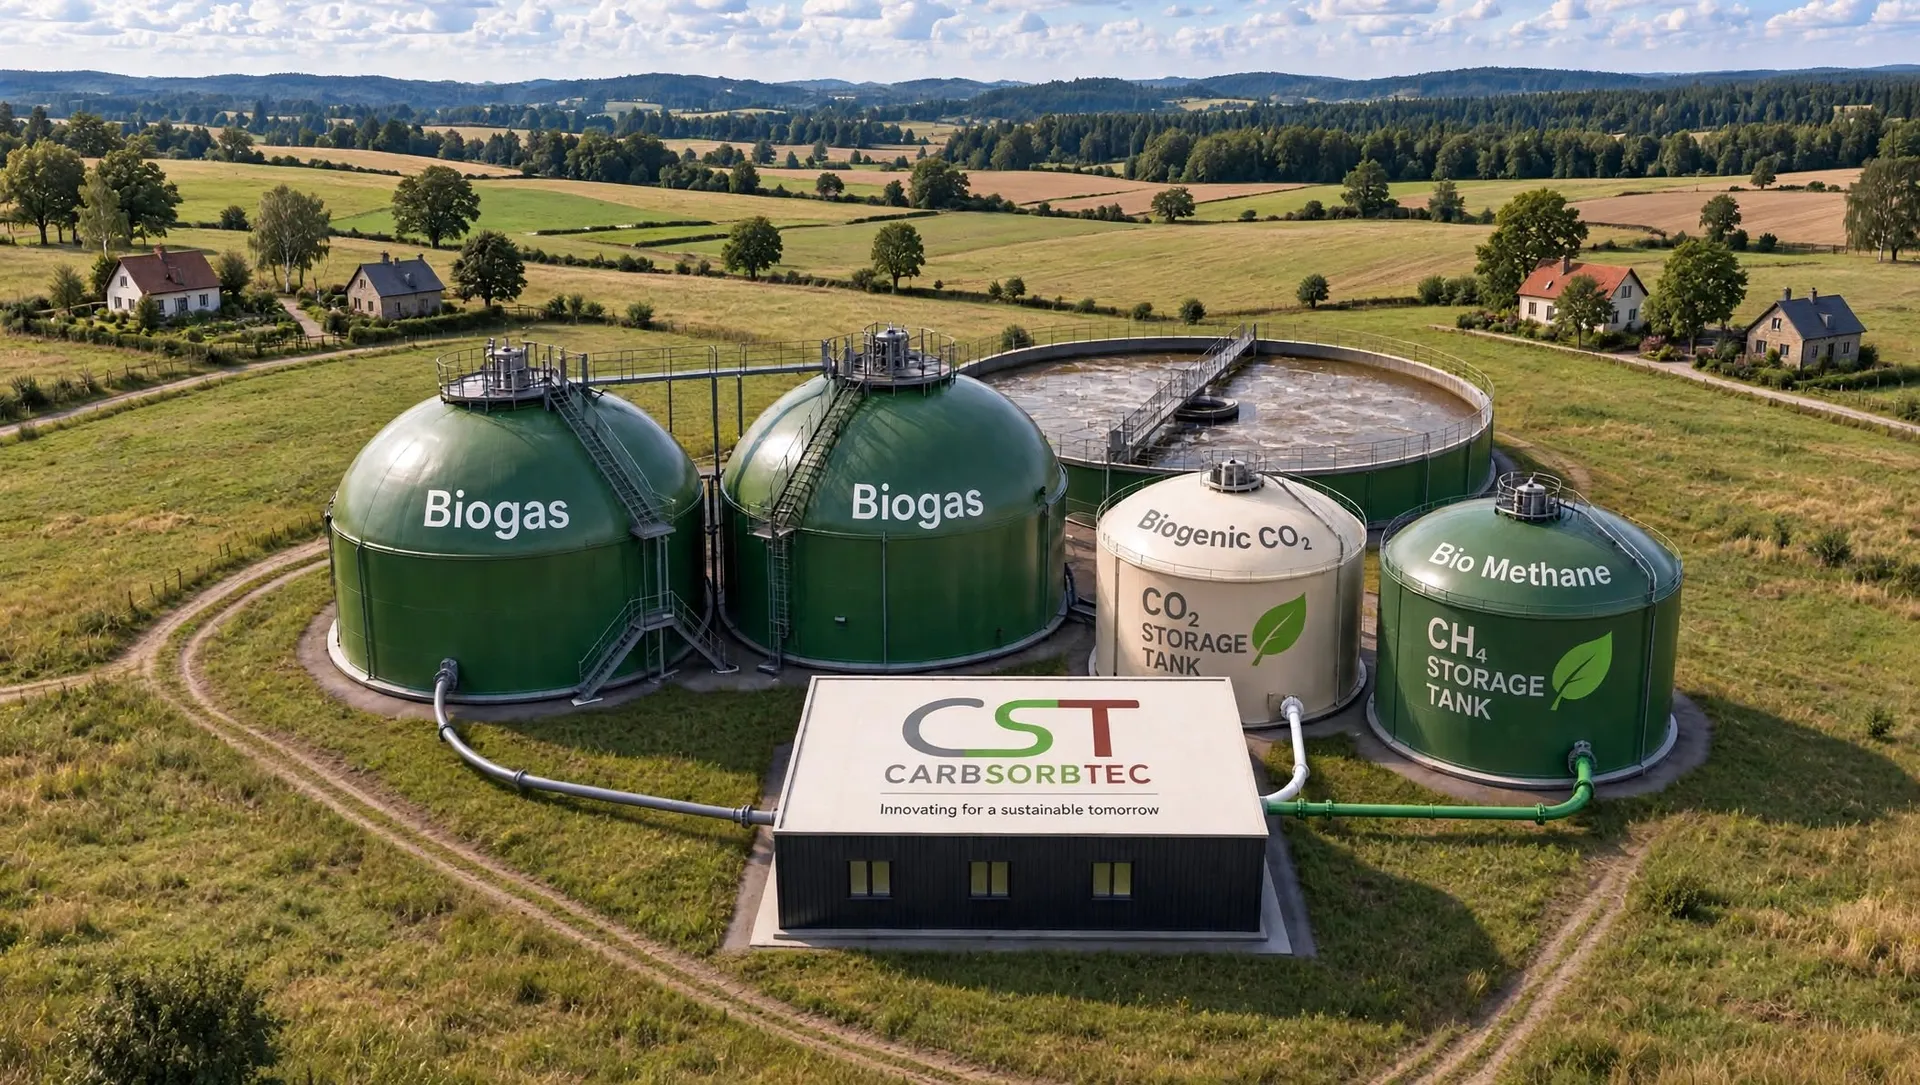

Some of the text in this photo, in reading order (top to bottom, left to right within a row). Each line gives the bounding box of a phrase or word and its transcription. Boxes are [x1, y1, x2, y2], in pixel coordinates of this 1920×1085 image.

[423, 489, 570, 540] Biogas
[852, 482, 984, 530] Biogas
[1137, 509, 1252, 549] Biogenic
[1428, 542, 1612, 587] Bio Methane
[1142, 622, 1248, 654] STORAGE
[1142, 647, 1201, 676] TANK
[1427, 655, 1545, 697] STORAGE
[1426, 683, 1492, 720] TANK
[902, 697, 1140, 758] CST
[884, 764, 1152, 785] CARBSORBTEC
[880, 802, 1160, 818] Innovating for a sustainable tomorrow
